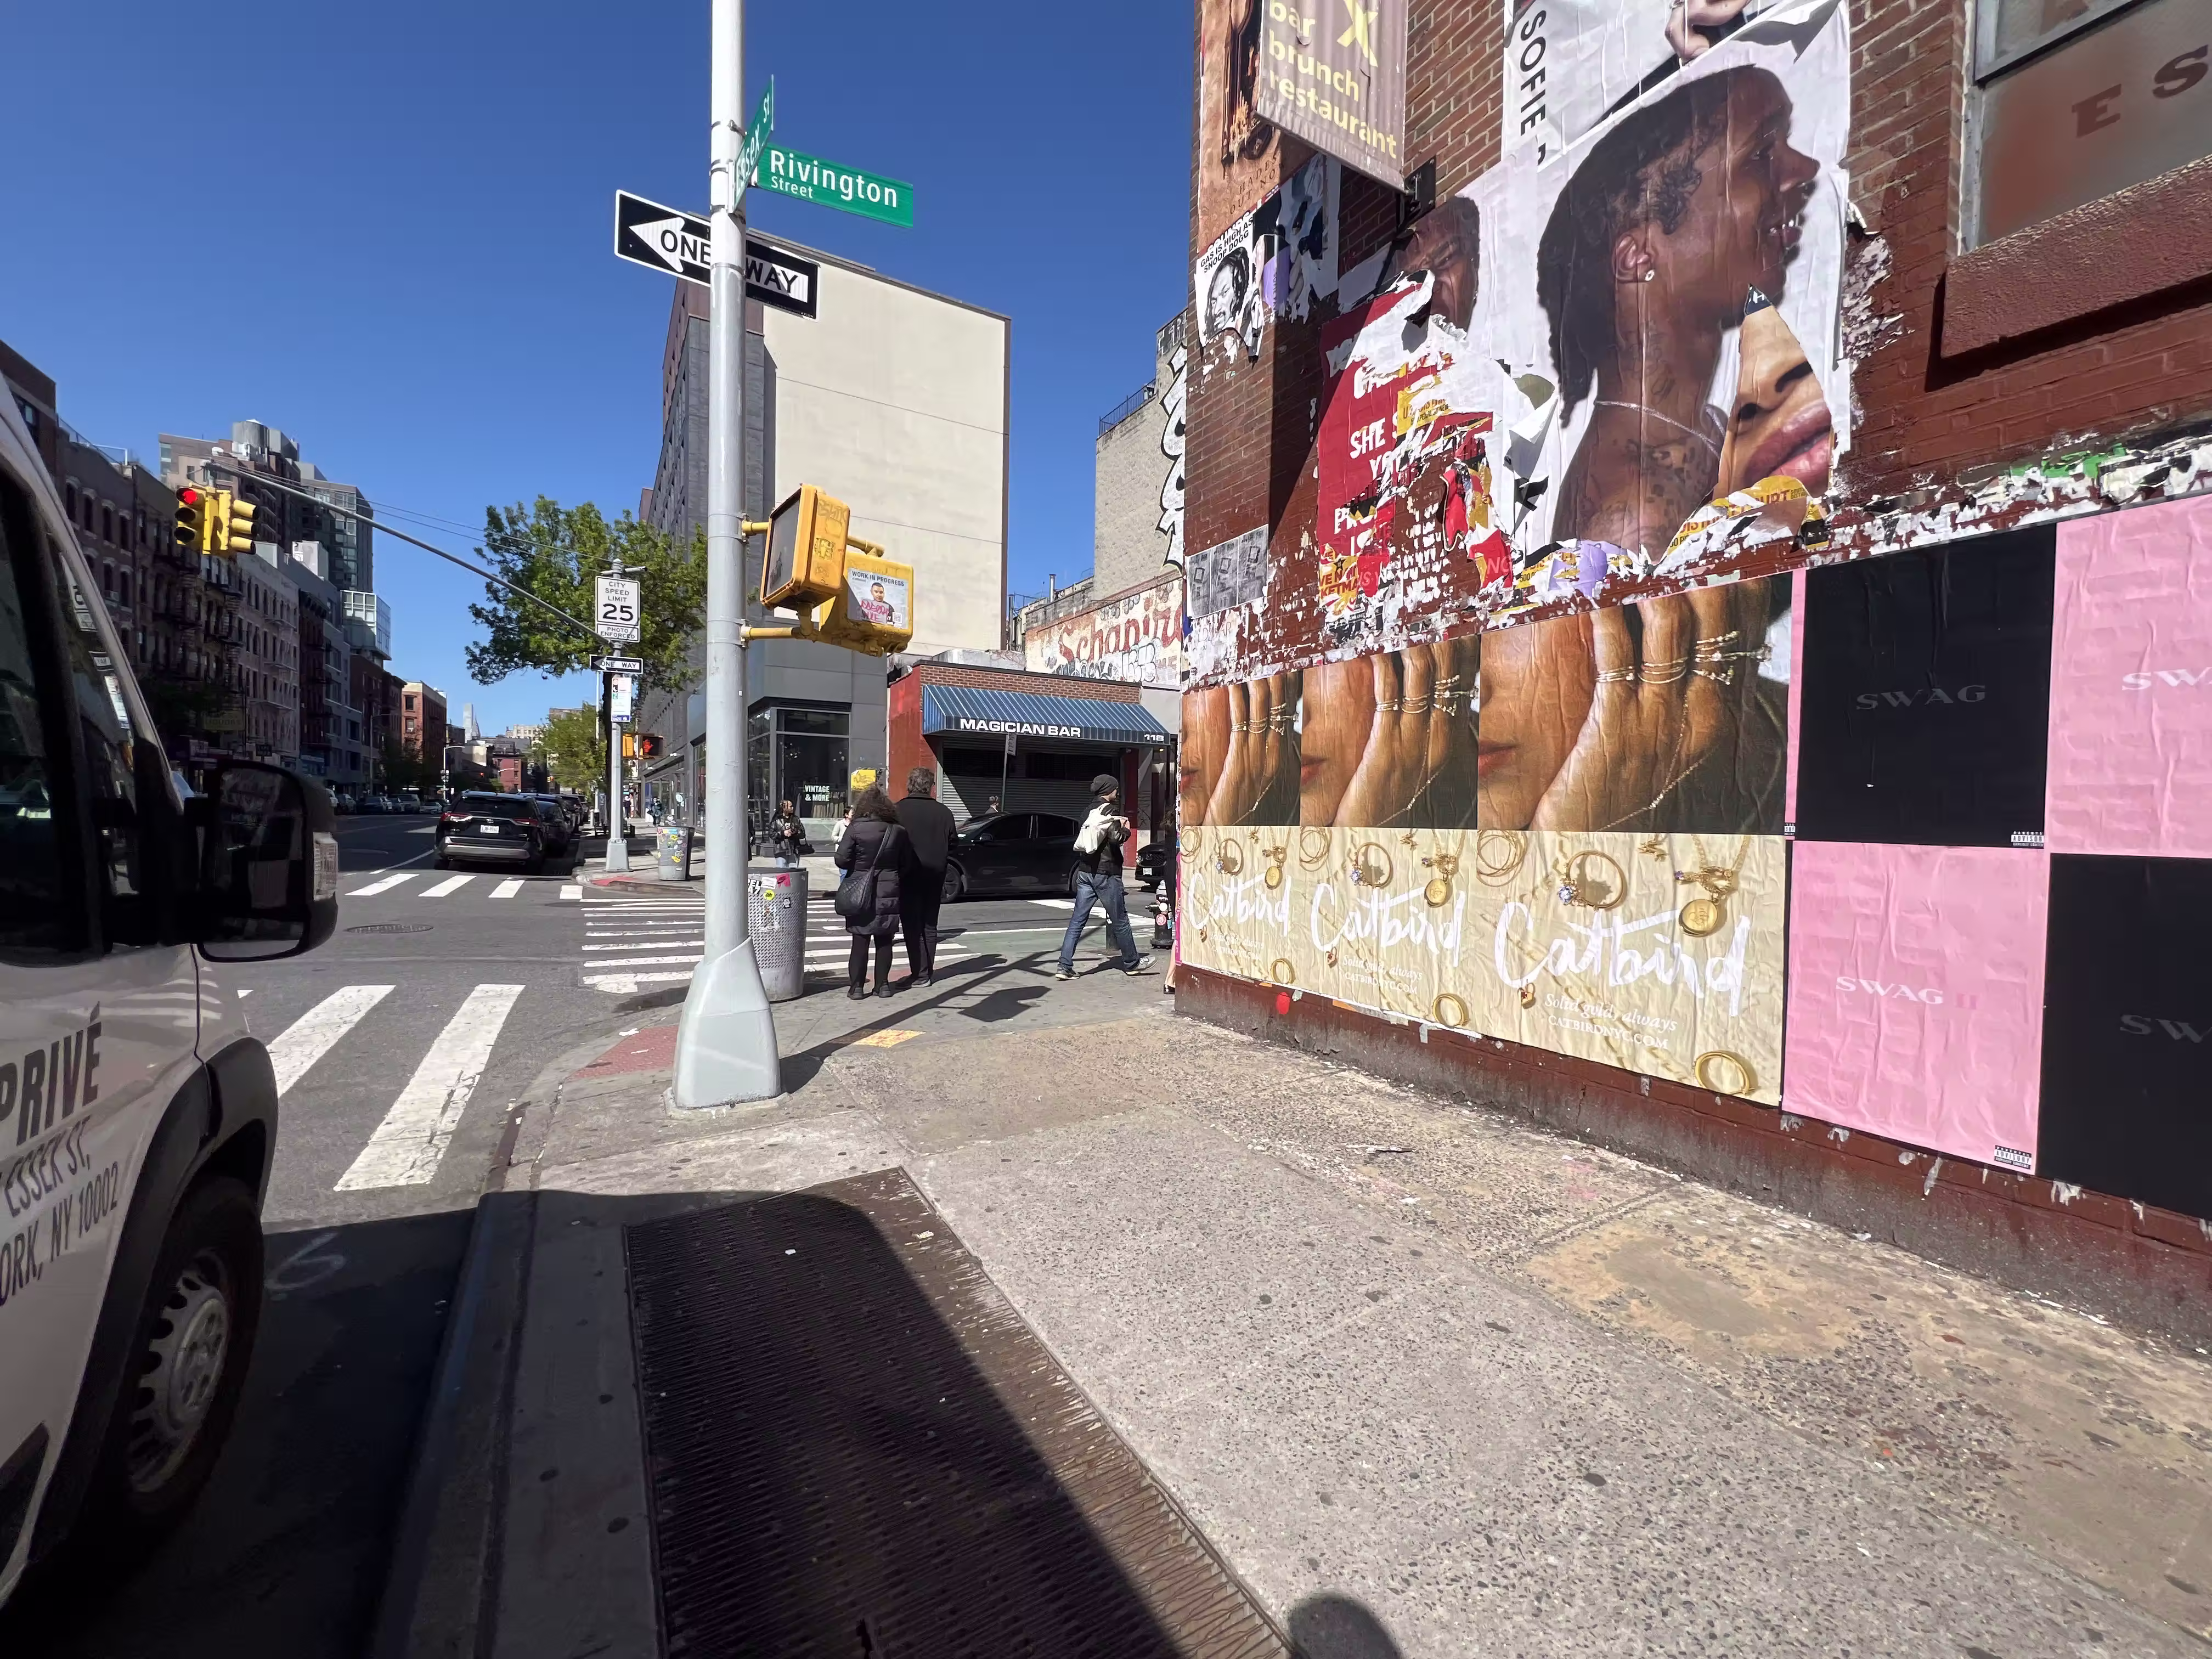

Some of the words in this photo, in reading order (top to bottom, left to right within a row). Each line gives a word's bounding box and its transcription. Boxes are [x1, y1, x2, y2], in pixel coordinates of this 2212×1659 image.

[1269, 0, 1316, 37] bar
[1269, 30, 1359, 101] brunch
[1520, 10, 1546, 136] SOFIE
[1269, 70, 1397, 159] restaurant
[736, 123, 760, 192] Essex
[771, 150, 898, 207] Rivington
[771, 176, 813, 199] Street
[661, 229, 710, 264] ONE
[746, 257, 798, 294] WAY
[1201, 251, 1214, 267] GAS
[1216, 244, 1222, 255] IS
[1224, 227, 1241, 247] HIGH
[1204, 248, 1227, 273] SNOOP
[1229, 229, 1249, 252] DOGG
[1350, 417, 1385, 459] SHE
[605, 588, 629, 596] SPEED
[852, 571, 868, 579] WORK
[877, 575, 904, 586] PROGRESS
[602, 603, 634, 622] 25
[1856, 685, 1985, 710] SWAG
[2122, 667, 2212, 691] SW
[960, 718, 1045, 735] MAGICIAN
[1047, 725, 1081, 738] BAR
[1144, 733, 1164, 742] 118
[804, 785, 830, 793] VINTAGE
[1188, 872, 1292, 937] Catbird
[1311, 883, 1466, 967] Catbird
[1389, 964, 1423, 983] always
[1494, 901, 1751, 1017] Catbird
[1836, 976, 1944, 1005] SWAG
[1544, 993, 1579, 1012] Solid
[1581, 1002, 1618, 1021] gold,
[1622, 1008, 1678, 1034] always
[1548, 1015, 1668, 1049] CATBIRDNYC.COM
[4, 1130, 67, 1218] ESSEX
[51, 1194, 72, 1263] NY
[79, 1161, 118, 1238] 10002
